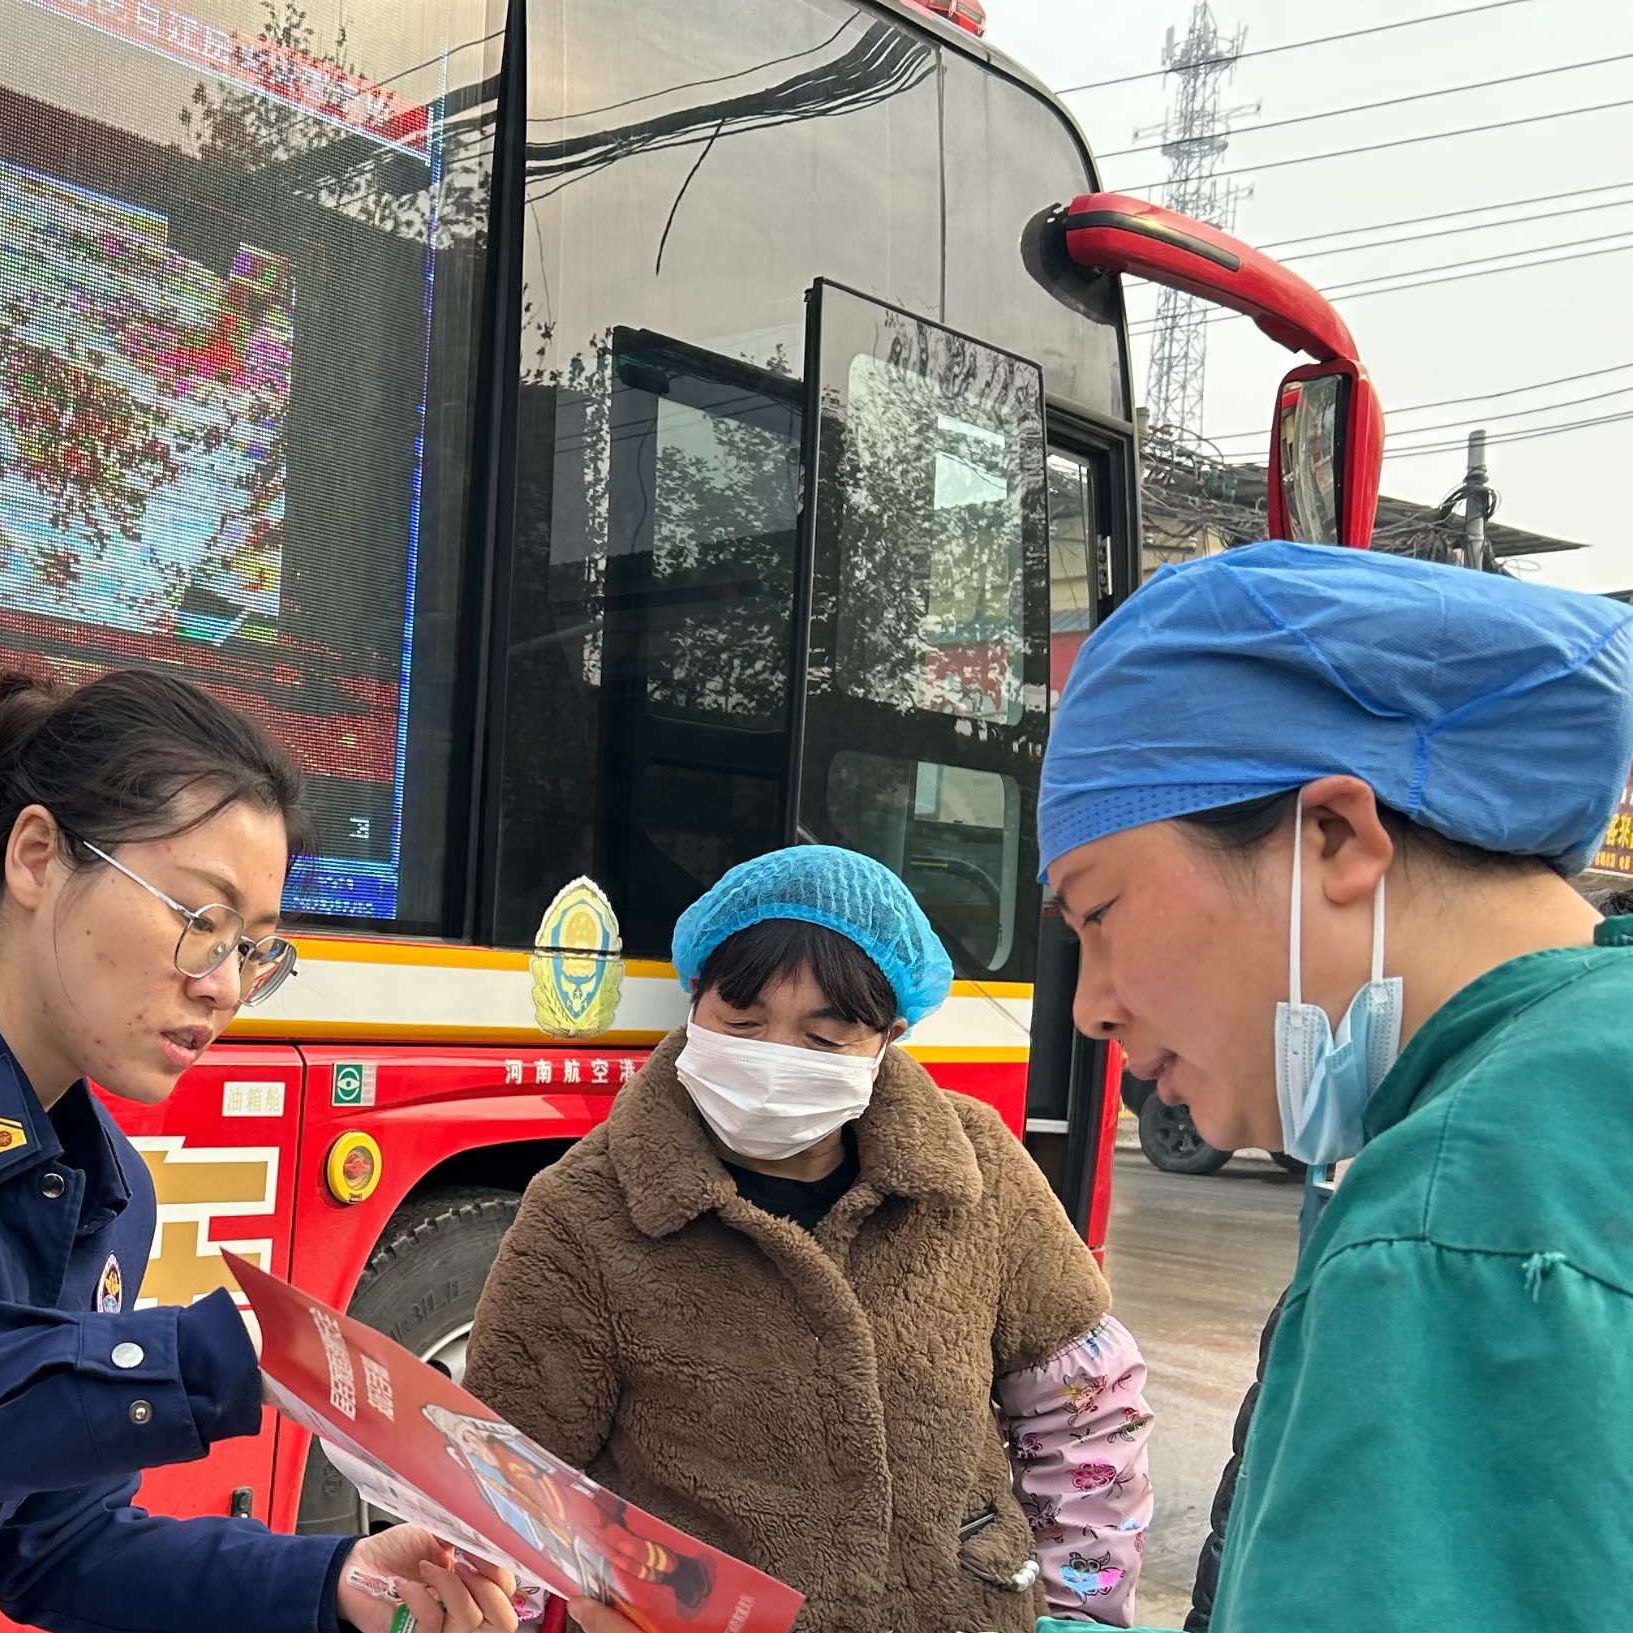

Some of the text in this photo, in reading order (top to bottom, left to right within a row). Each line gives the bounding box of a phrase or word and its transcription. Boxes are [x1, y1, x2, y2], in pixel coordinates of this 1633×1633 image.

[225, 1086, 282, 1113] 油箱舱
[359, 1353, 395, 1423] 知识手册
